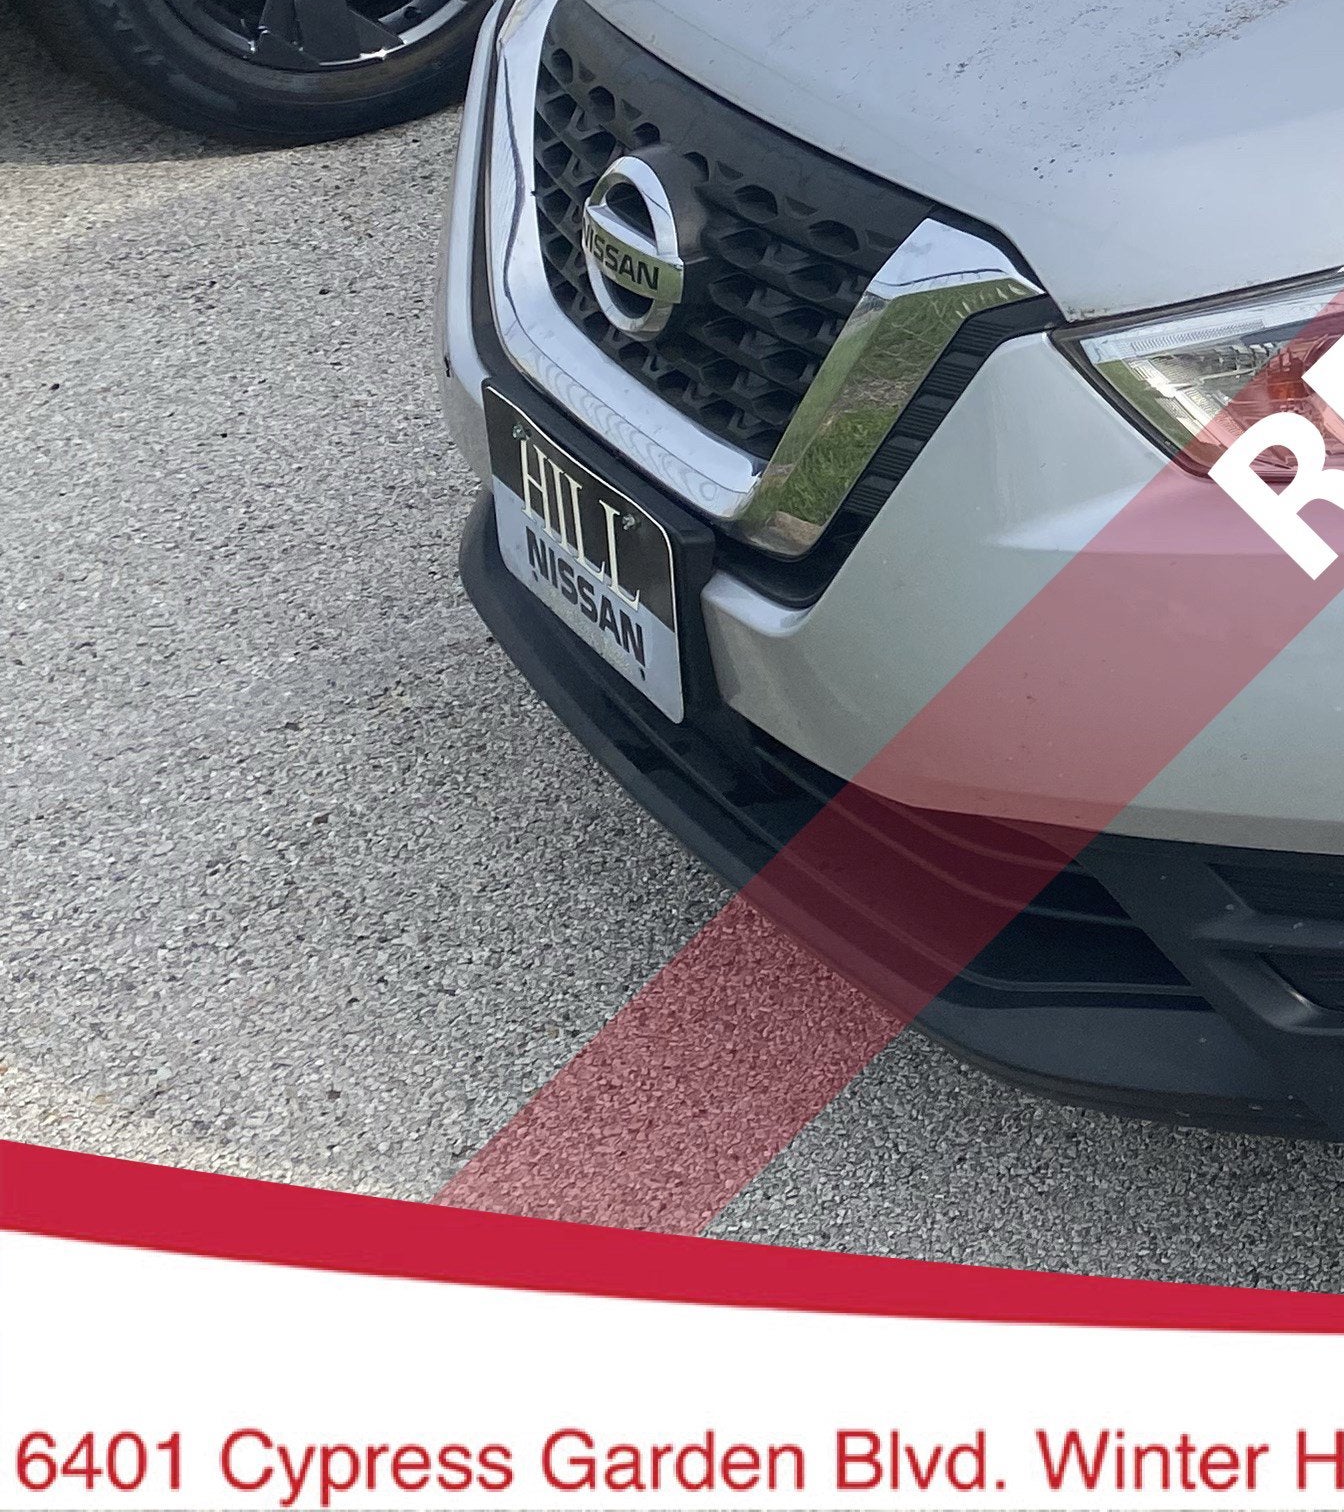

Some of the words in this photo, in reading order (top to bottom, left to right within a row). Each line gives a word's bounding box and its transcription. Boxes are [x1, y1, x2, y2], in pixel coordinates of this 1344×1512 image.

[581, 216, 659, 291] NISSAN
[518, 436, 640, 612] HILL
[525, 525, 646, 669] NISSAN
